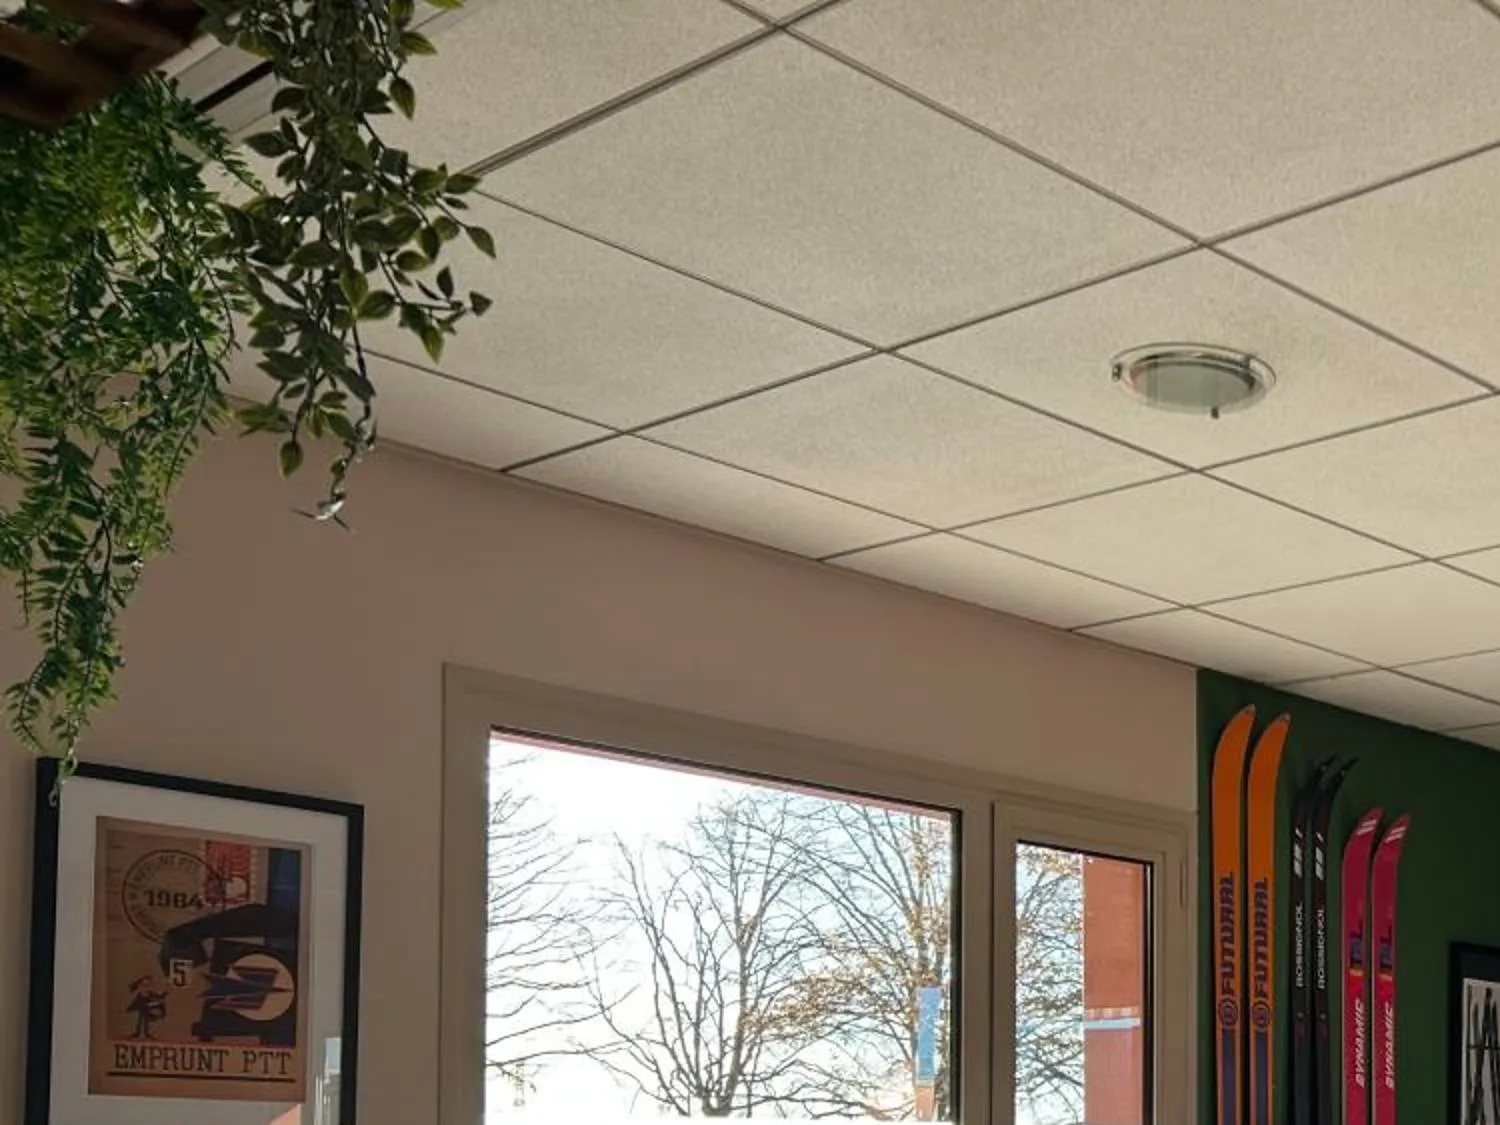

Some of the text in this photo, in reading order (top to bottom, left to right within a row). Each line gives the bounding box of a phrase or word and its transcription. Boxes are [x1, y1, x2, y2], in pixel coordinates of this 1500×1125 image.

[144, 890, 204, 909] 1984
[113, 1044, 293, 1075] EMPRUNT PTT
